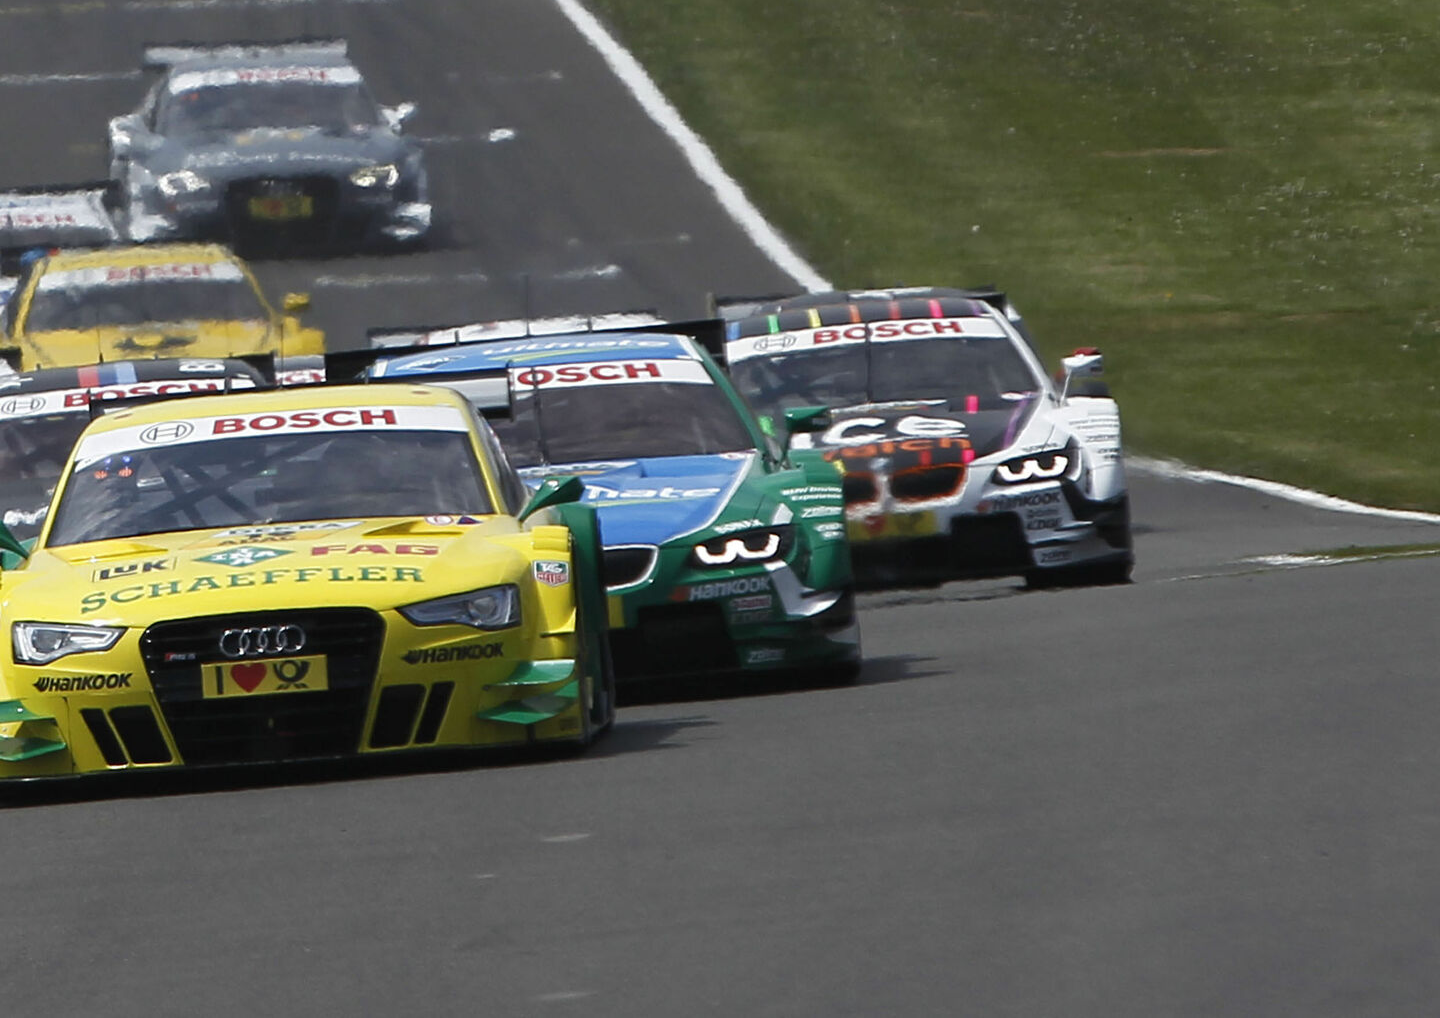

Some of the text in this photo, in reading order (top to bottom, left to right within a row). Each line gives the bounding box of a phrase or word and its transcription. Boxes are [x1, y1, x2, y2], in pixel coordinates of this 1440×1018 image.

[813, 321, 964, 345] BOSCH
[517, 363, 662, 386] OSCH
[212, 409, 397, 435] BOSCH
[311, 544, 439, 557] FAG
[81, 566, 425, 614] SCHAEFFLER
[215, 666, 224, 695] I
